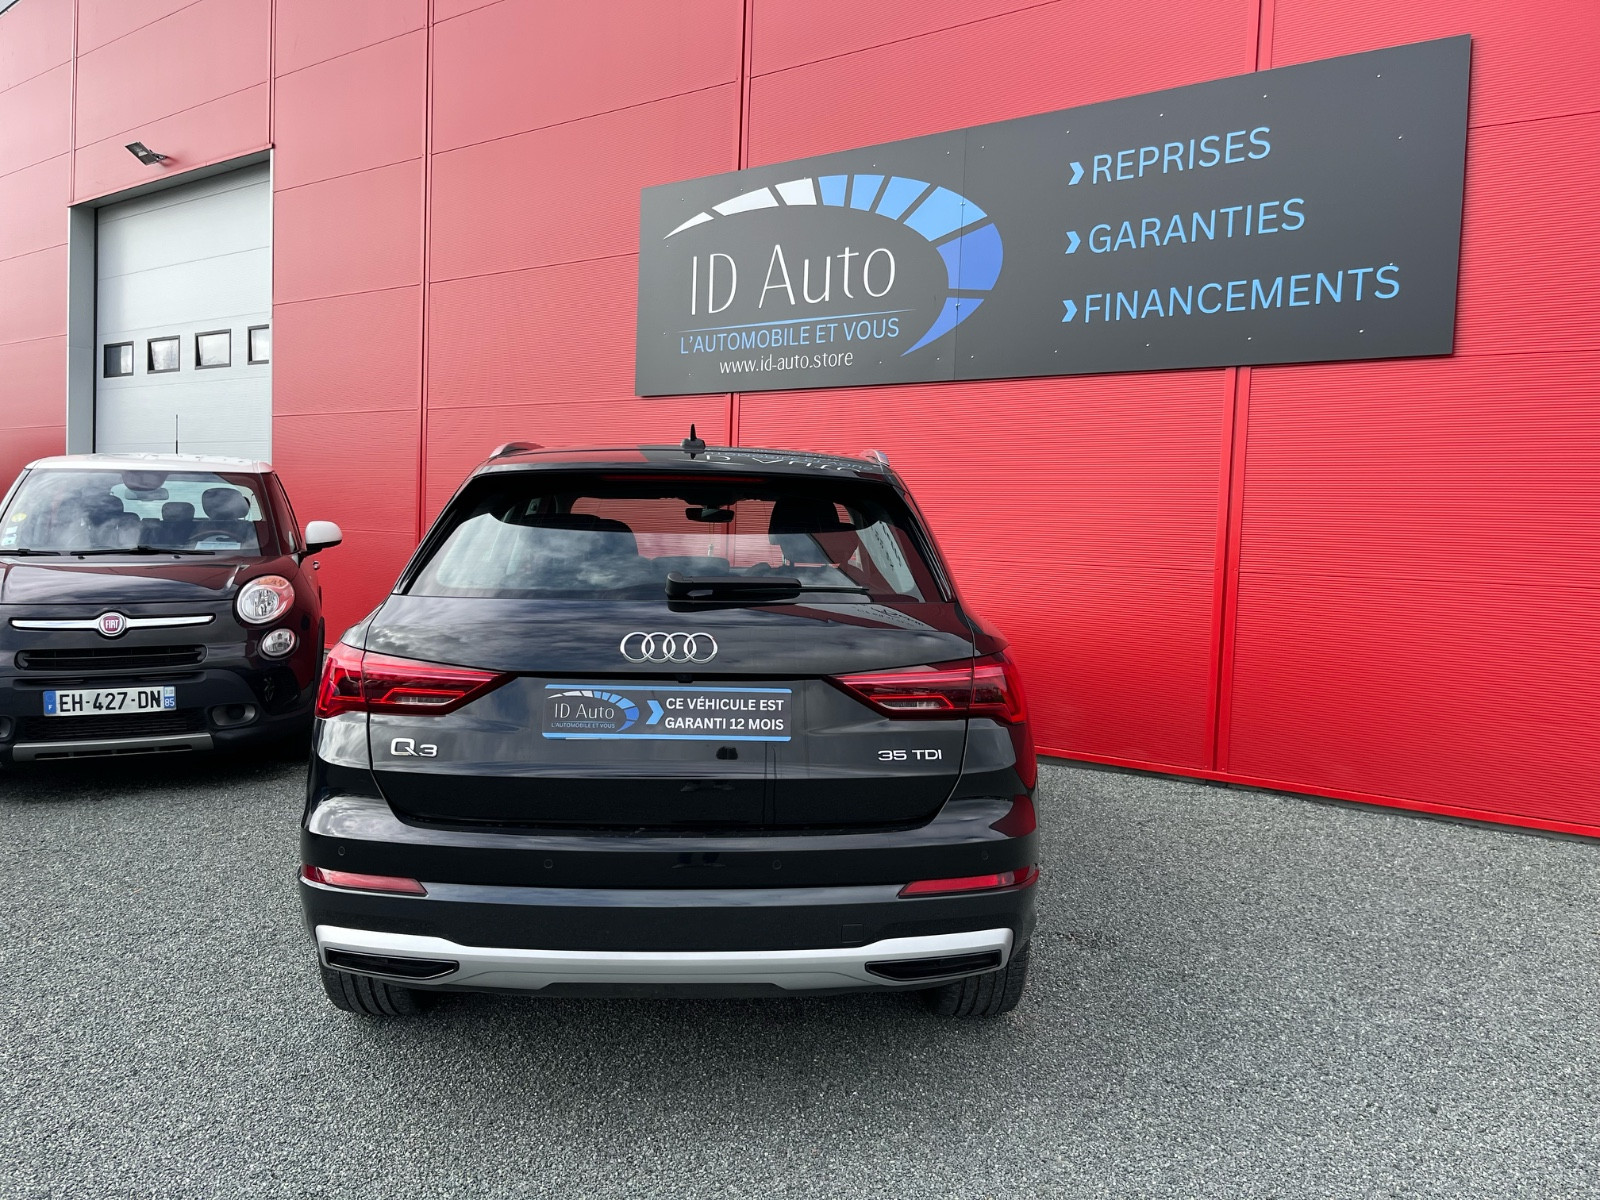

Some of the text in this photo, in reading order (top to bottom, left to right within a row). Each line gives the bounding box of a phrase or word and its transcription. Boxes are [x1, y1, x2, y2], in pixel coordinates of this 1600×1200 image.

[1092, 126, 1271, 184] REPRISES
[1088, 198, 1305, 254] GARANTIES
[691, 244, 896, 316] ID Auto
[1084, 265, 1400, 323] FINANCEMENTS
[680, 317, 900, 354] L'AUTOMOBILE ET VOUS
[719, 351, 854, 374] www.id-auto.store
[105, 619, 119, 629] FIAT
[59, 690, 161, 712] EH-427-DN
[164, 698, 175, 707] 85
[554, 702, 615, 720] ID Auto
[666, 695, 784, 711] CE VÉHICULE EST
[664, 717, 785, 731] GARANTI 12 MOIS
[390, 738, 438, 758] Q3
[877, 749, 943, 761] 35 TDI
